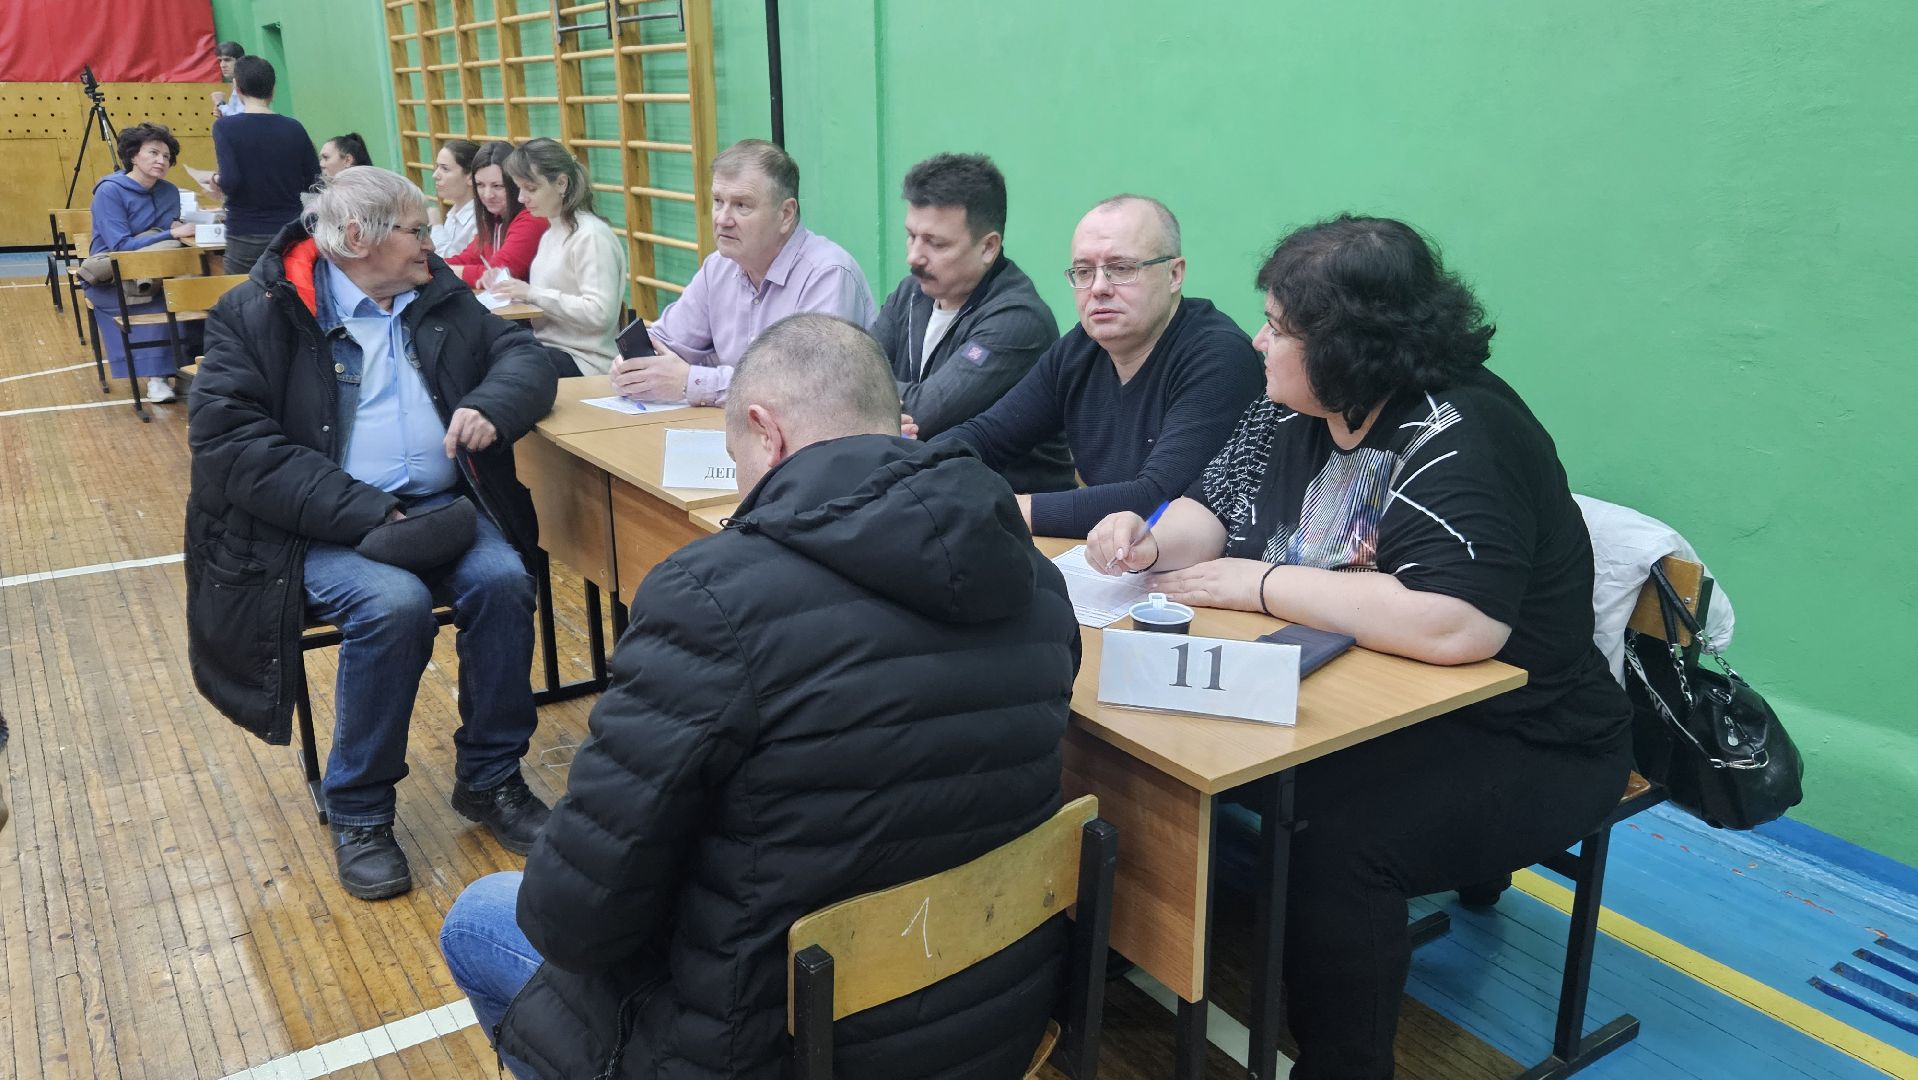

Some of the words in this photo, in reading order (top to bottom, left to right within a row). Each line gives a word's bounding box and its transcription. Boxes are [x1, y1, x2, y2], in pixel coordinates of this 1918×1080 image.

[704, 466, 736, 480] ДЕП
[1168, 642, 1228, 691] 11
[901, 897, 932, 958] 1
